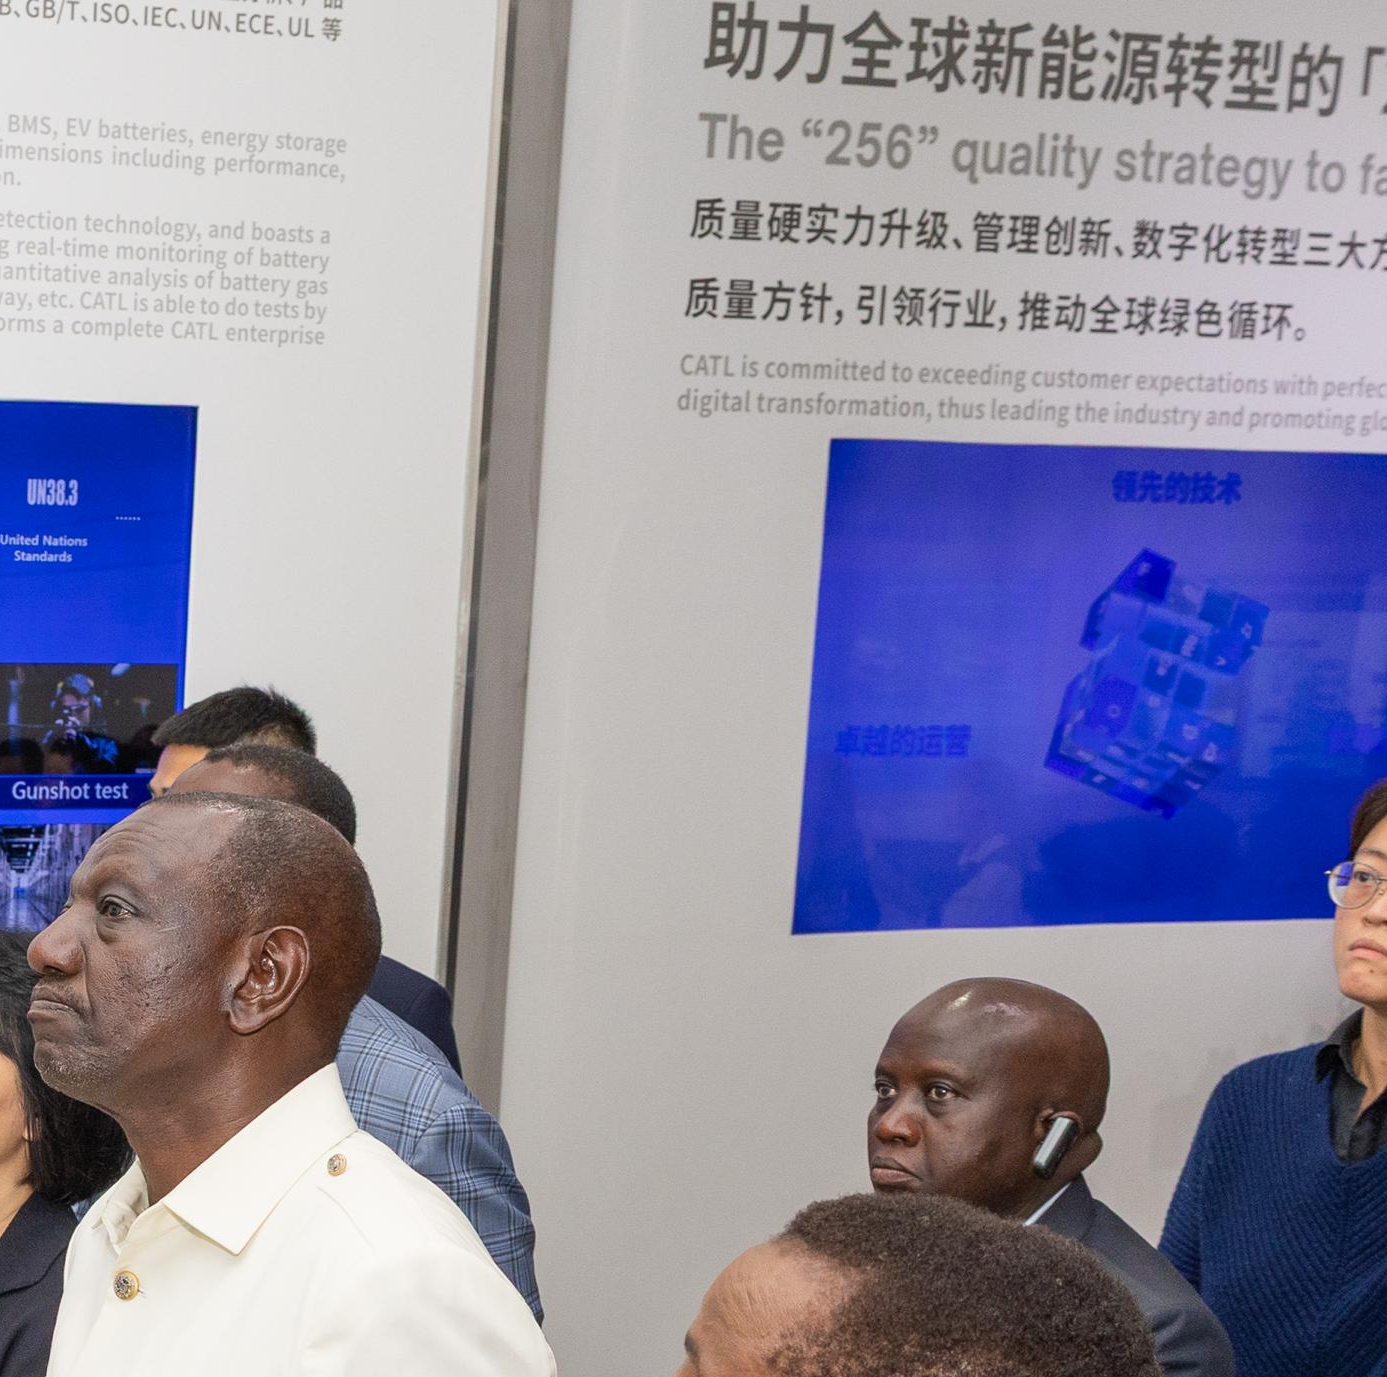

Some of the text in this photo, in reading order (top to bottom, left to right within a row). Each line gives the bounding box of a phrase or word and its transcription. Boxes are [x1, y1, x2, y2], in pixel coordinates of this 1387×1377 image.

[321, 17, 343, 42] 等
[703, 0, 1387, 117] 助力全球新能源转型的「
[7, 113, 58, 141] BMS,
[66, 117, 92, 137] EV
[98, 118, 194, 149] batteries,
[200, 130, 269, 154] energy
[275, 132, 348, 158] storage
[698, 112, 785, 163] The
[951, 132, 1103, 191] quality
[1114, 138, 1294, 201] strategy
[1305, 149, 1347, 194] to
[26, 478, 79, 506] UN38.3
[0, 533, 88, 547] United Nations
[13, 550, 73, 563] Standards
[11, 780, 129, 800] Gunshot test
